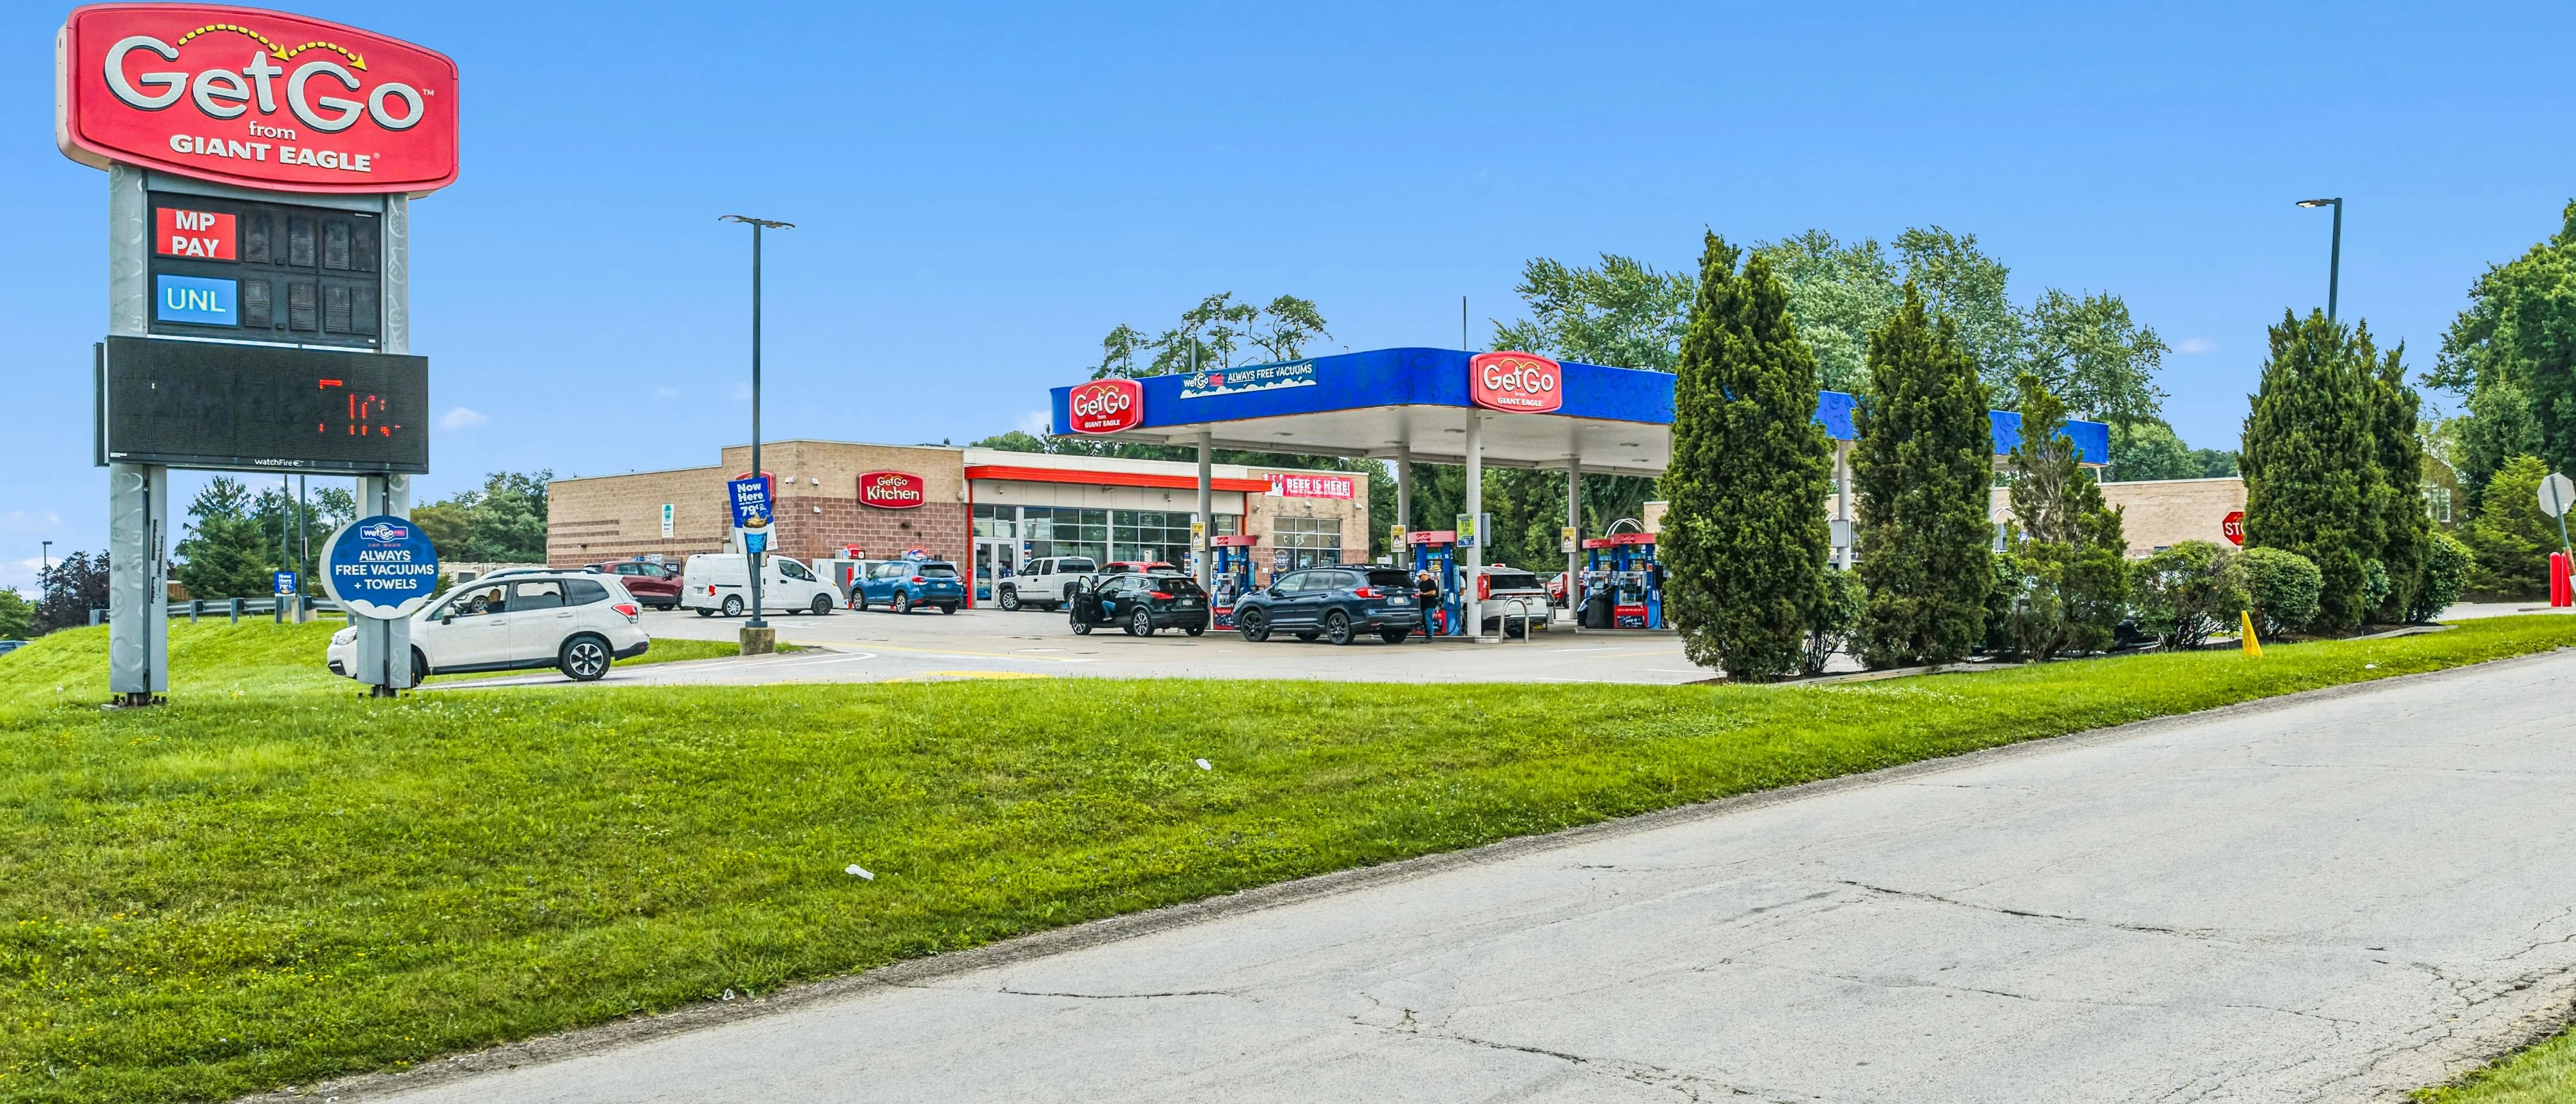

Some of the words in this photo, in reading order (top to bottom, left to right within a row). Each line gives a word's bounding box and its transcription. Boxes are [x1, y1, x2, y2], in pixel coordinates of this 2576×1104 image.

[104, 35, 424, 132] GetGo
[249, 120, 296, 140] from
[169, 134, 270, 161] GIANT
[279, 146, 372, 173] EAGLE
[176, 211, 215, 231] MP
[172, 235, 220, 258] PAY
[167, 287, 226, 312] UNL
[1227, 370, 1256, 383] ALWAYS
[1256, 368, 1274, 379] FREE
[1276, 364, 1312, 377] VACUUMS
[1483, 364, 1554, 394] GetGo
[1074, 391, 1130, 417] GetGo
[1497, 397, 1520, 405] GIANT
[1521, 399, 1543, 407] EAGLE
[737, 483, 762, 493] Now
[876, 477, 908, 486] GetGo
[1286, 478, 1311, 490] BEER
[1312, 479, 1321, 490] IS
[1324, 479, 1350, 493] HERE!
[737, 492, 764, 502] Here
[866, 485, 920, 500] Kitchen
[2225, 522, 2245, 536] ST
[359, 549, 412, 562] ALWAYS
[1273, 555, 1289, 564] beer
[335, 564, 368, 576] FREE
[370, 564, 435, 576] VACUUMS
[364, 578, 417, 590] TOWELS
